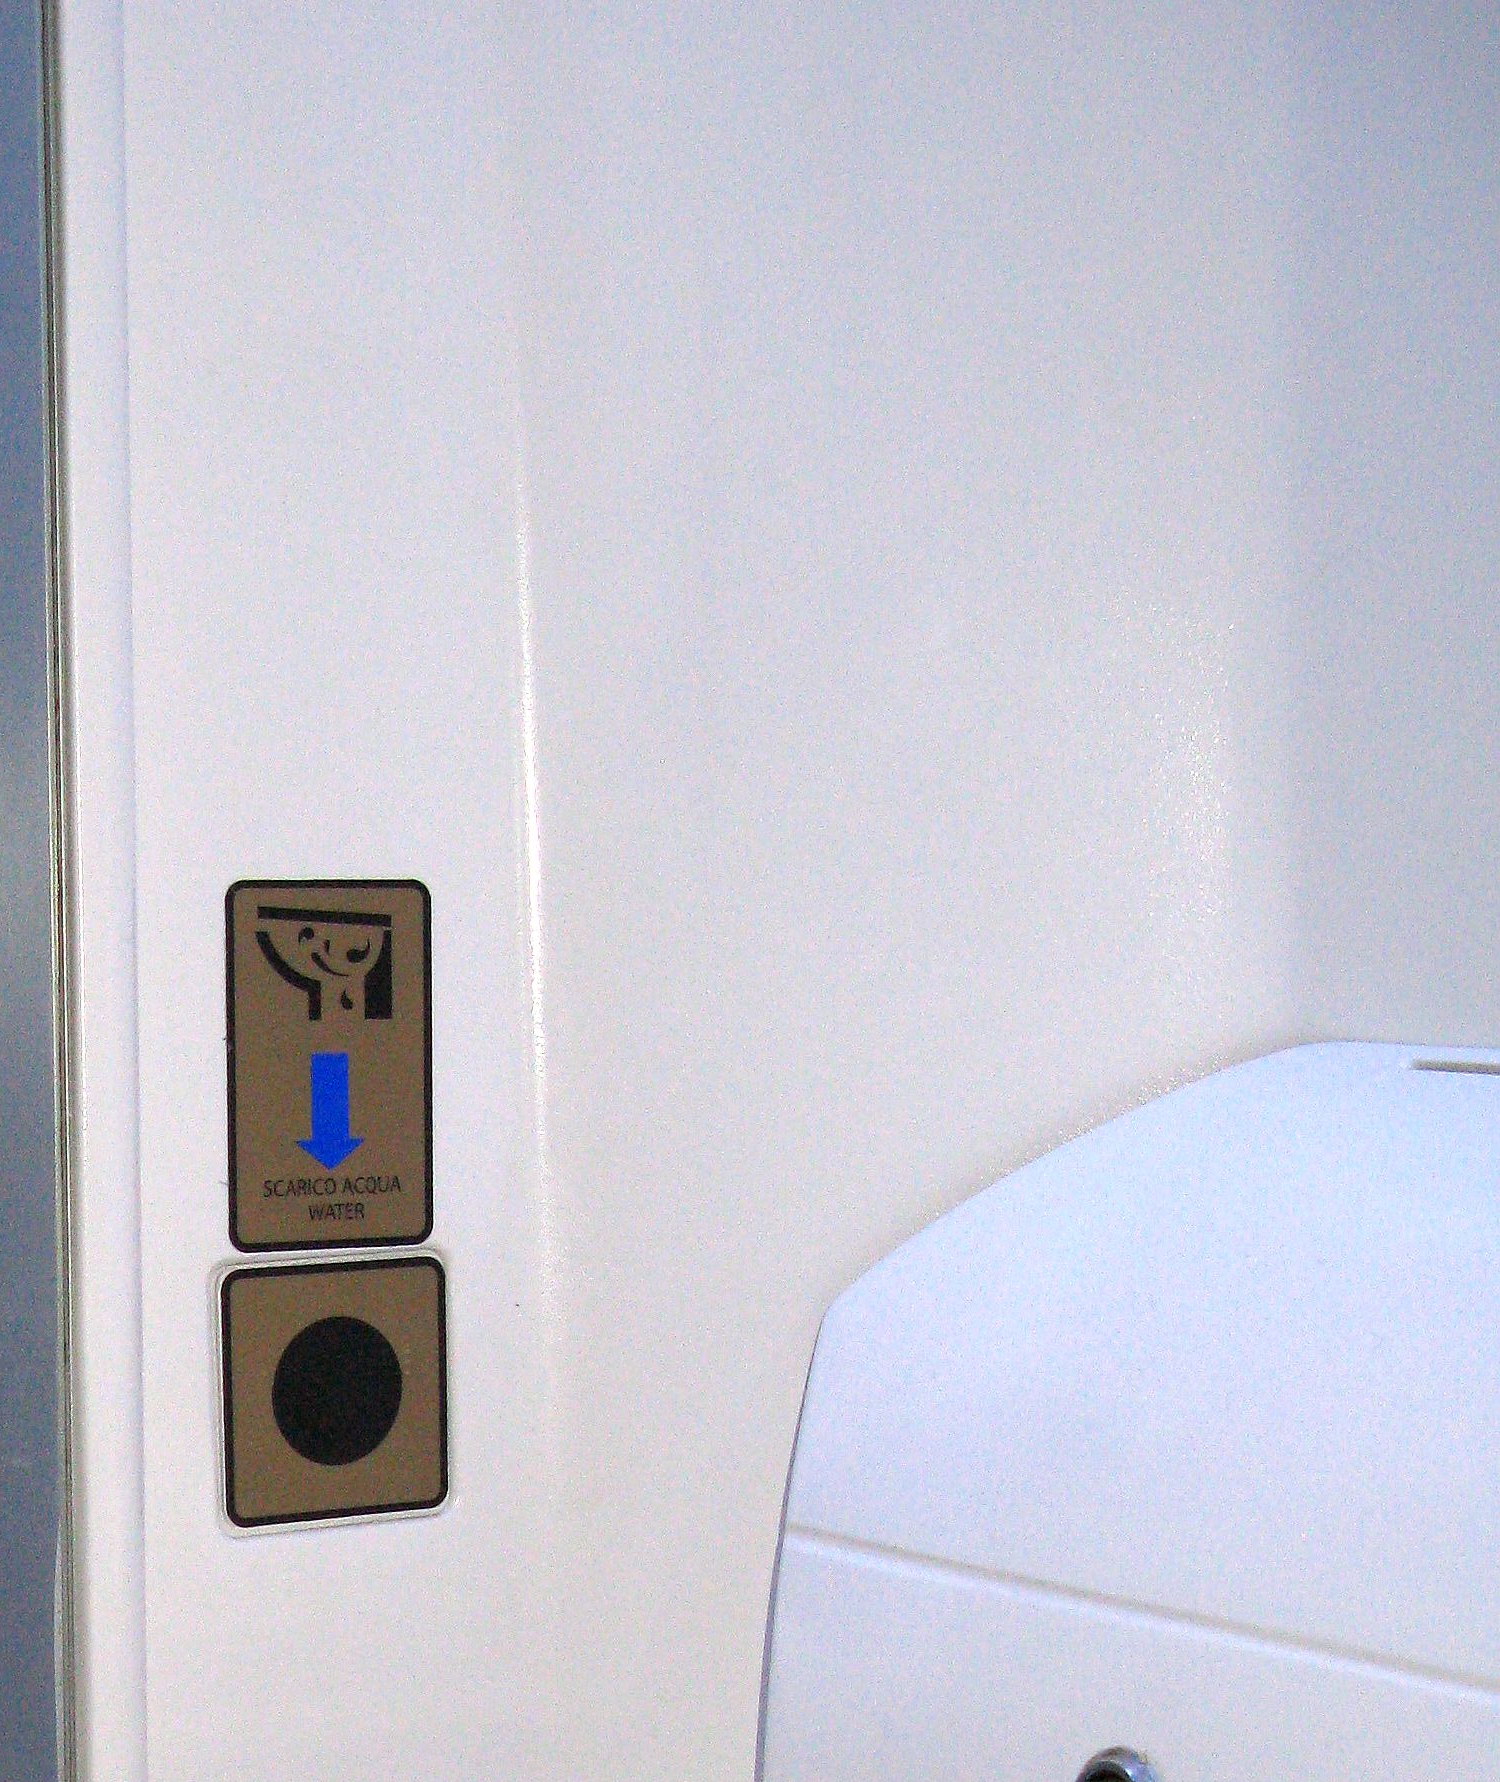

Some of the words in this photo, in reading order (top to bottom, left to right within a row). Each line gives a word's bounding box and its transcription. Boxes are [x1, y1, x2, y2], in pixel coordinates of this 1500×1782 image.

[263, 1178, 337, 1198] SCARICO
[342, 1175, 401, 1195] ACQUA
[308, 1203, 365, 1221] WATER
